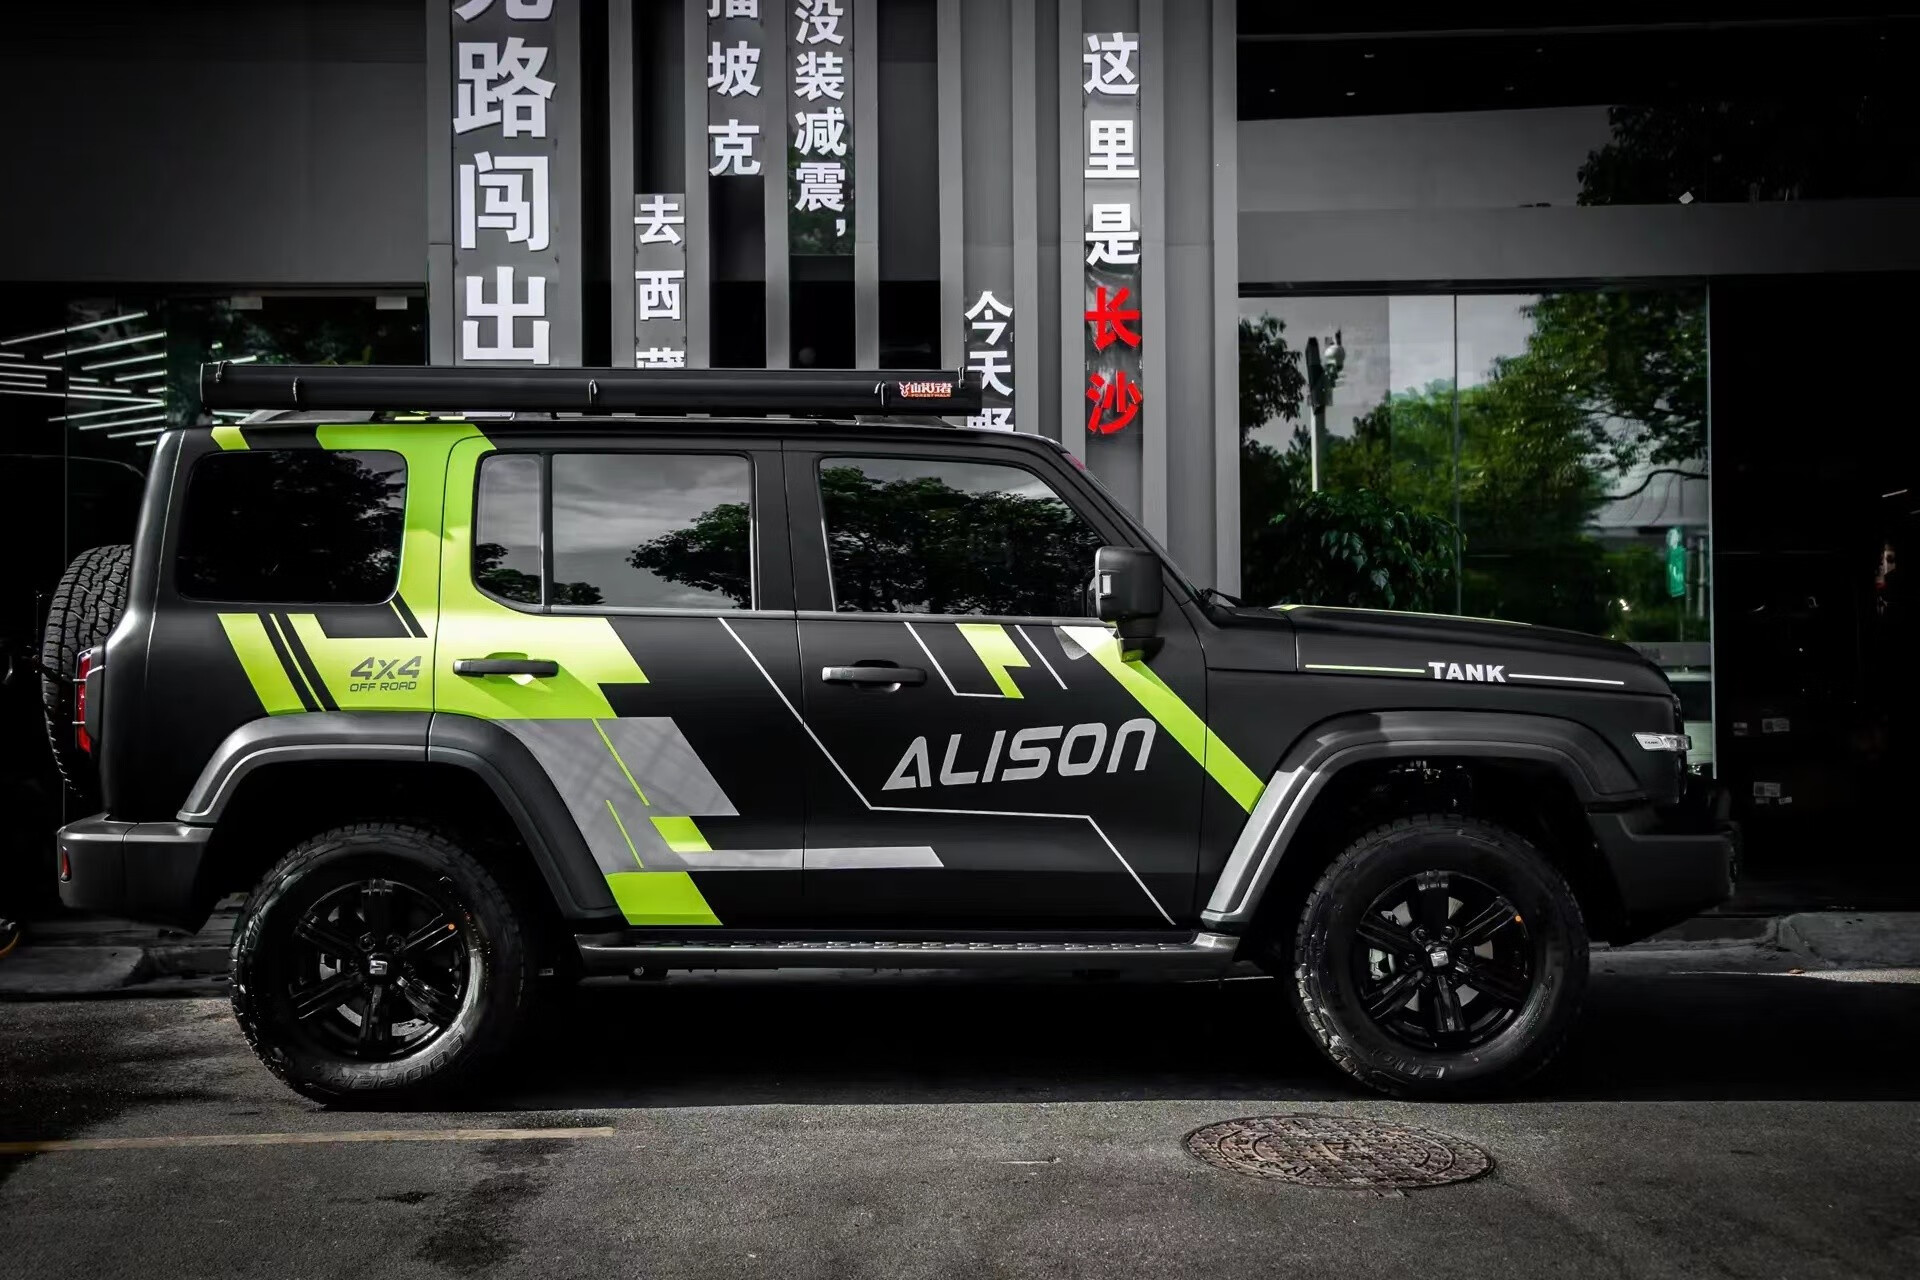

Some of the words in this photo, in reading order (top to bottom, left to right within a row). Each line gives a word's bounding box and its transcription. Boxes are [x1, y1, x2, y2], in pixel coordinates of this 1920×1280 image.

[454, 0, 555, 365] 路闯出
[1083, 32, 1142, 434] 这里是长沙
[349, 683, 376, 692] OFF
[380, 681, 417, 691] ROAD
[1428, 661, 1506, 683] TANK
[882, 718, 1157, 790] ALISON
